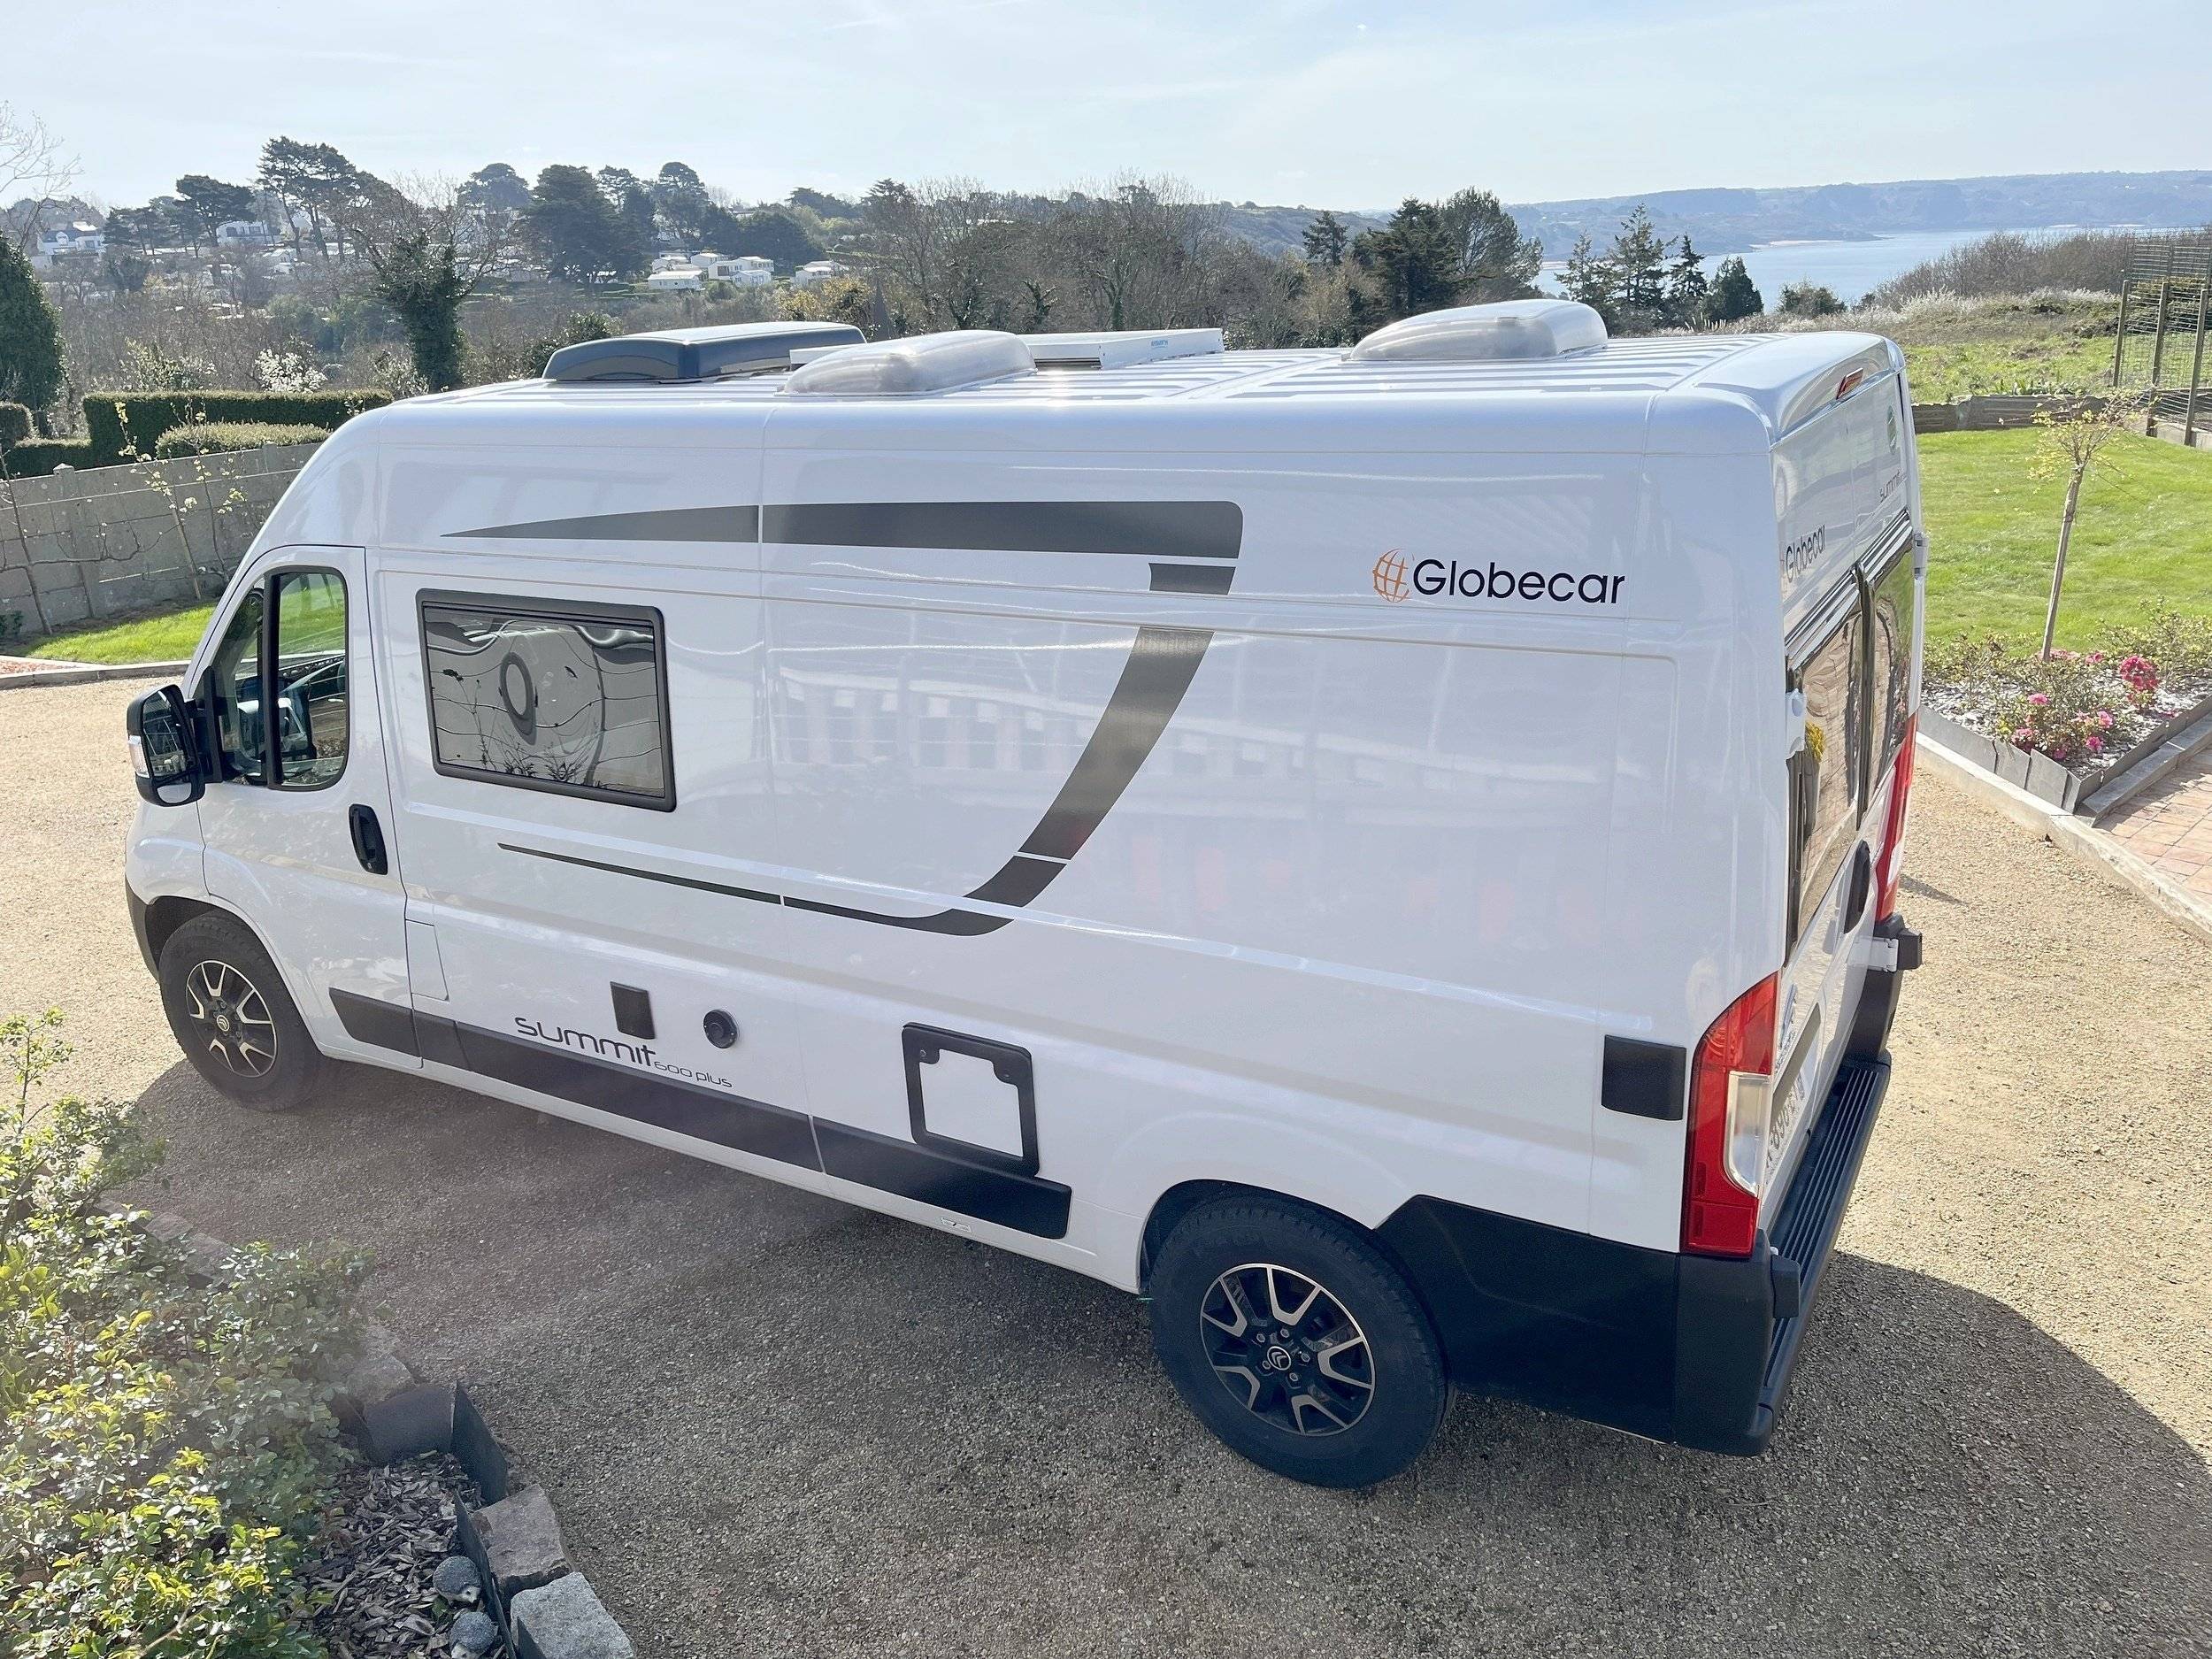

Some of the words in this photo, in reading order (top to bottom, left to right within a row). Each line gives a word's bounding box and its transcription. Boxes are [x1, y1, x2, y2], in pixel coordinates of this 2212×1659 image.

[1413, 558, 1625, 604] Globecar
[1786, 524, 1825, 583] Globecar
[514, 1017, 657, 1067] summit
[654, 1061, 692, 1077] 600
[695, 1071, 733, 1087] plus
